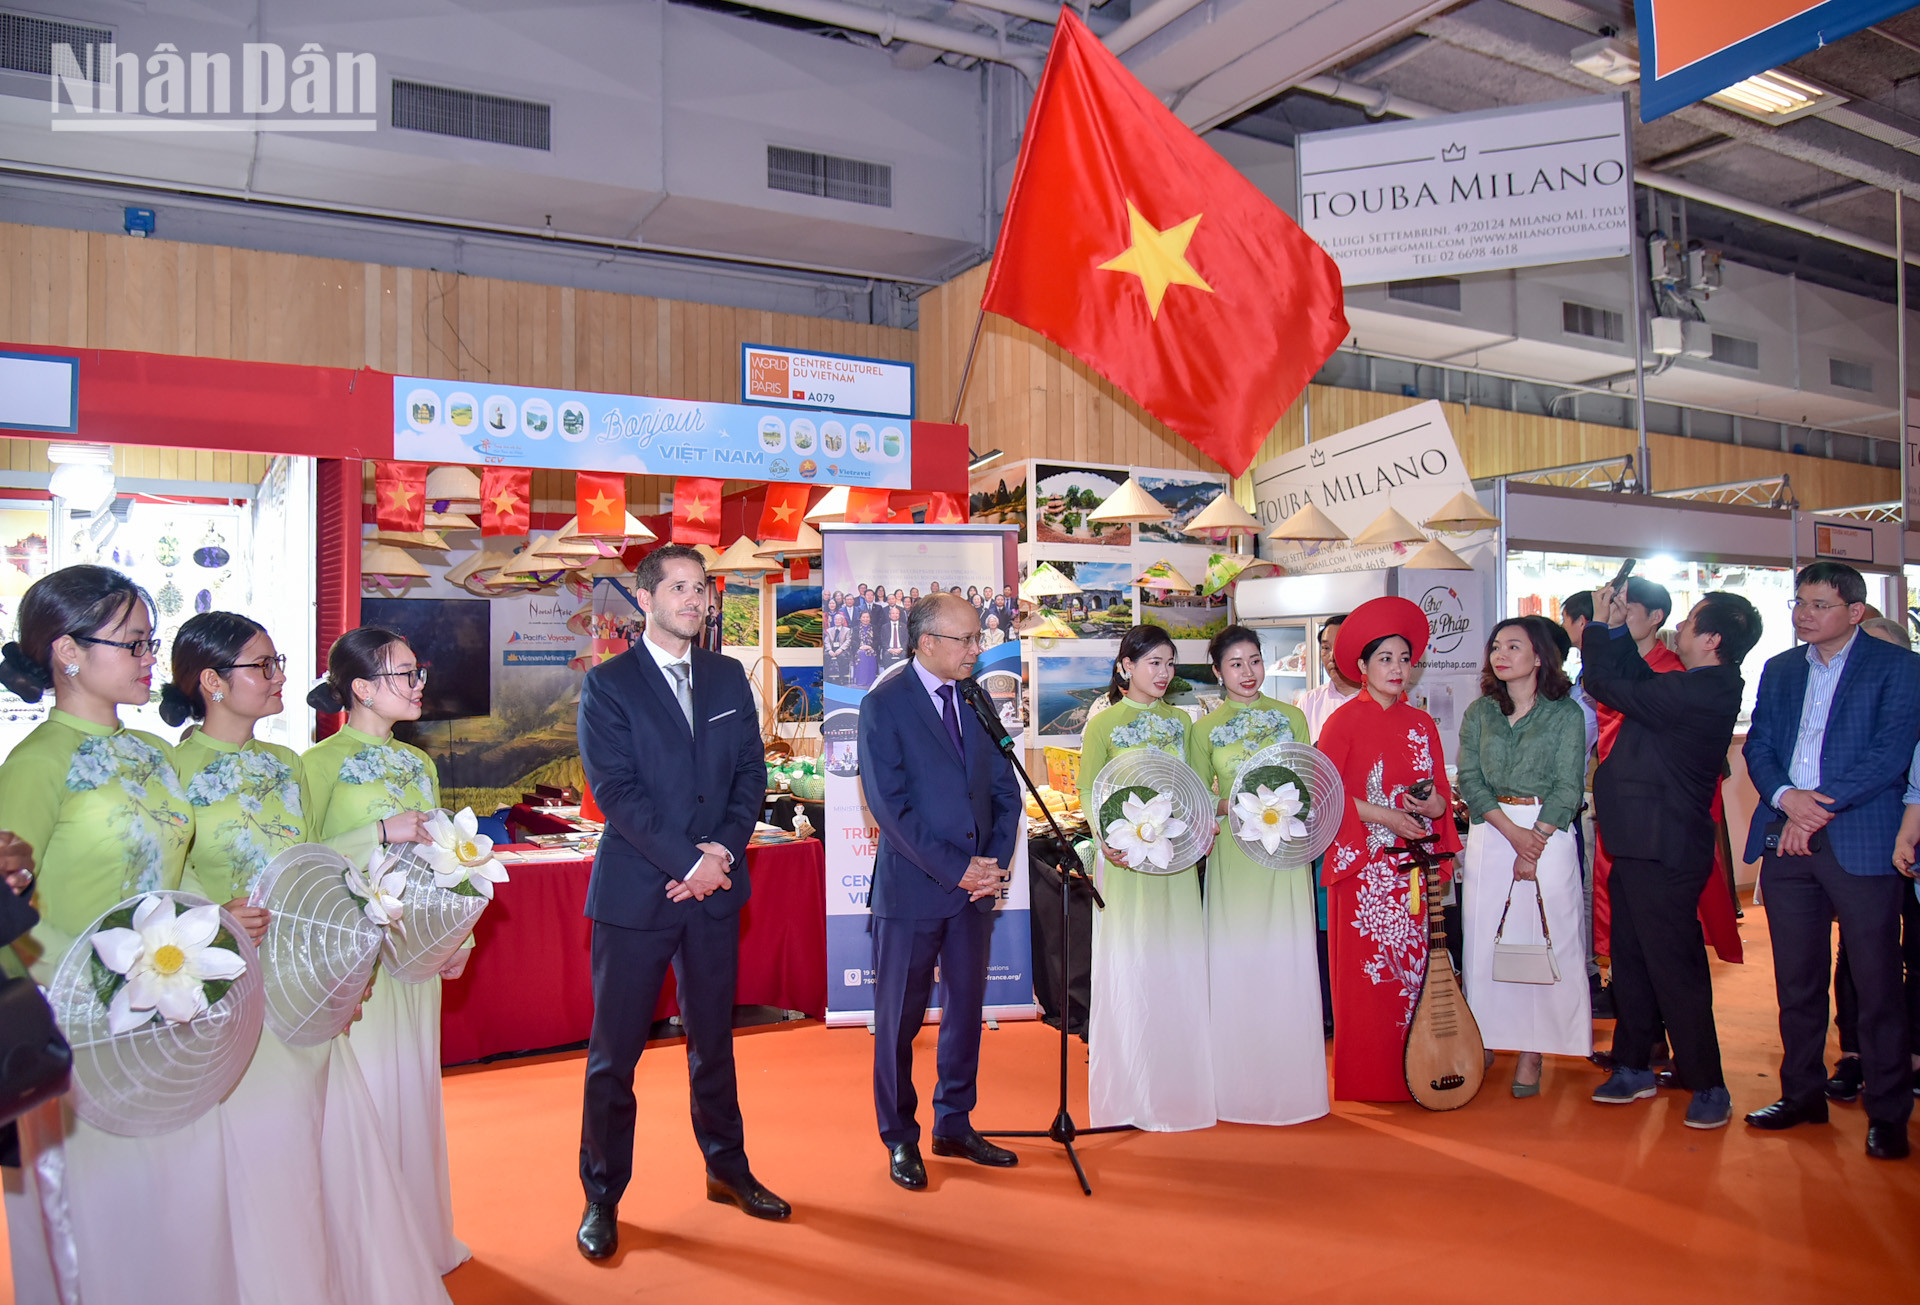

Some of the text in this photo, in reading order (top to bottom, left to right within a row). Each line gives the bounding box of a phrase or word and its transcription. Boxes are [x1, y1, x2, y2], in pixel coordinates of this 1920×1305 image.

[1303, 159, 1624, 220] TOUBA MILANO
[1332, 235, 1364, 248] LUIGI
[1509, 213, 1562, 228] MILANO
[1592, 205, 1627, 218] ITALY
[1440, 251, 1454, 262] 02
[1458, 247, 1486, 260] 6698
[1490, 243, 1518, 257] 4618
[751, 356, 788, 371] WORLD
[793, 357, 884, 376] CENTRE CULTUREL
[752, 368, 765, 380] IN
[793, 368, 856, 383] DU VIETNAM
[752, 381, 781, 394] PARIS
[808, 392, 835, 403] A079
[596, 407, 706, 449] Bonjour
[657, 443, 765, 466] VIỆT NAM
[838, 468, 871, 477] Vietravel
[1322, 449, 1447, 507] MILANO
[1439, 612, 1470, 634] Pháp
[523, 633, 547, 641] Pacific
[547, 634, 575, 643] Voyages
[843, 827, 880, 840] TRUN
[852, 841, 878, 859] VIỆ
